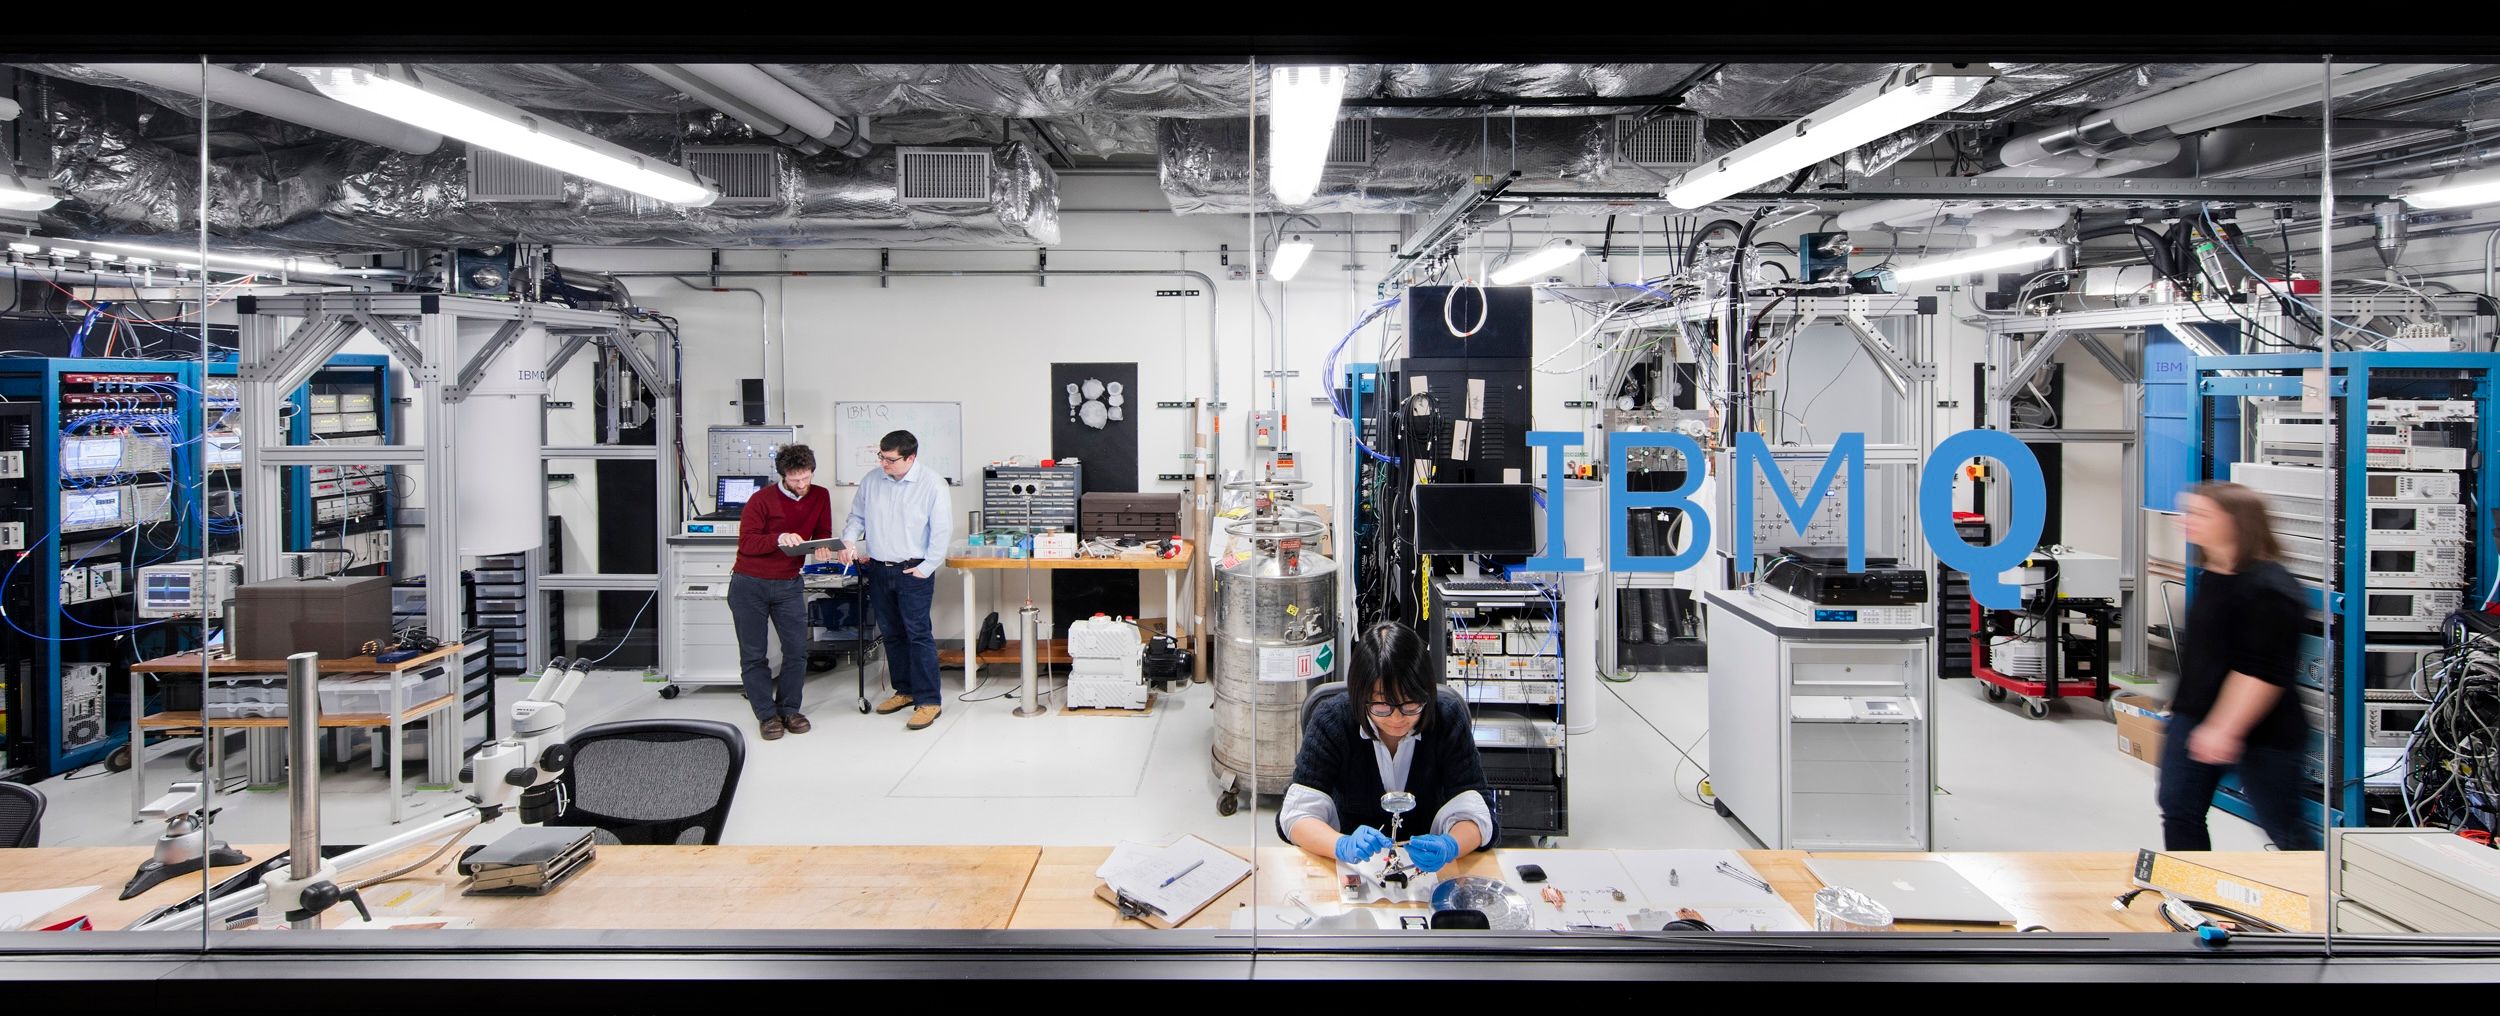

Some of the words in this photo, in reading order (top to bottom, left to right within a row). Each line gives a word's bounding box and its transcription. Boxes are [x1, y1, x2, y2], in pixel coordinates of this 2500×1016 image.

[2156, 362, 2182, 372] IBM
[847, 405, 871, 419] IBM
[876, 404, 889, 421] Q
[1526, 431, 1865, 573] IBM
[1919, 428, 2047, 610] Q
